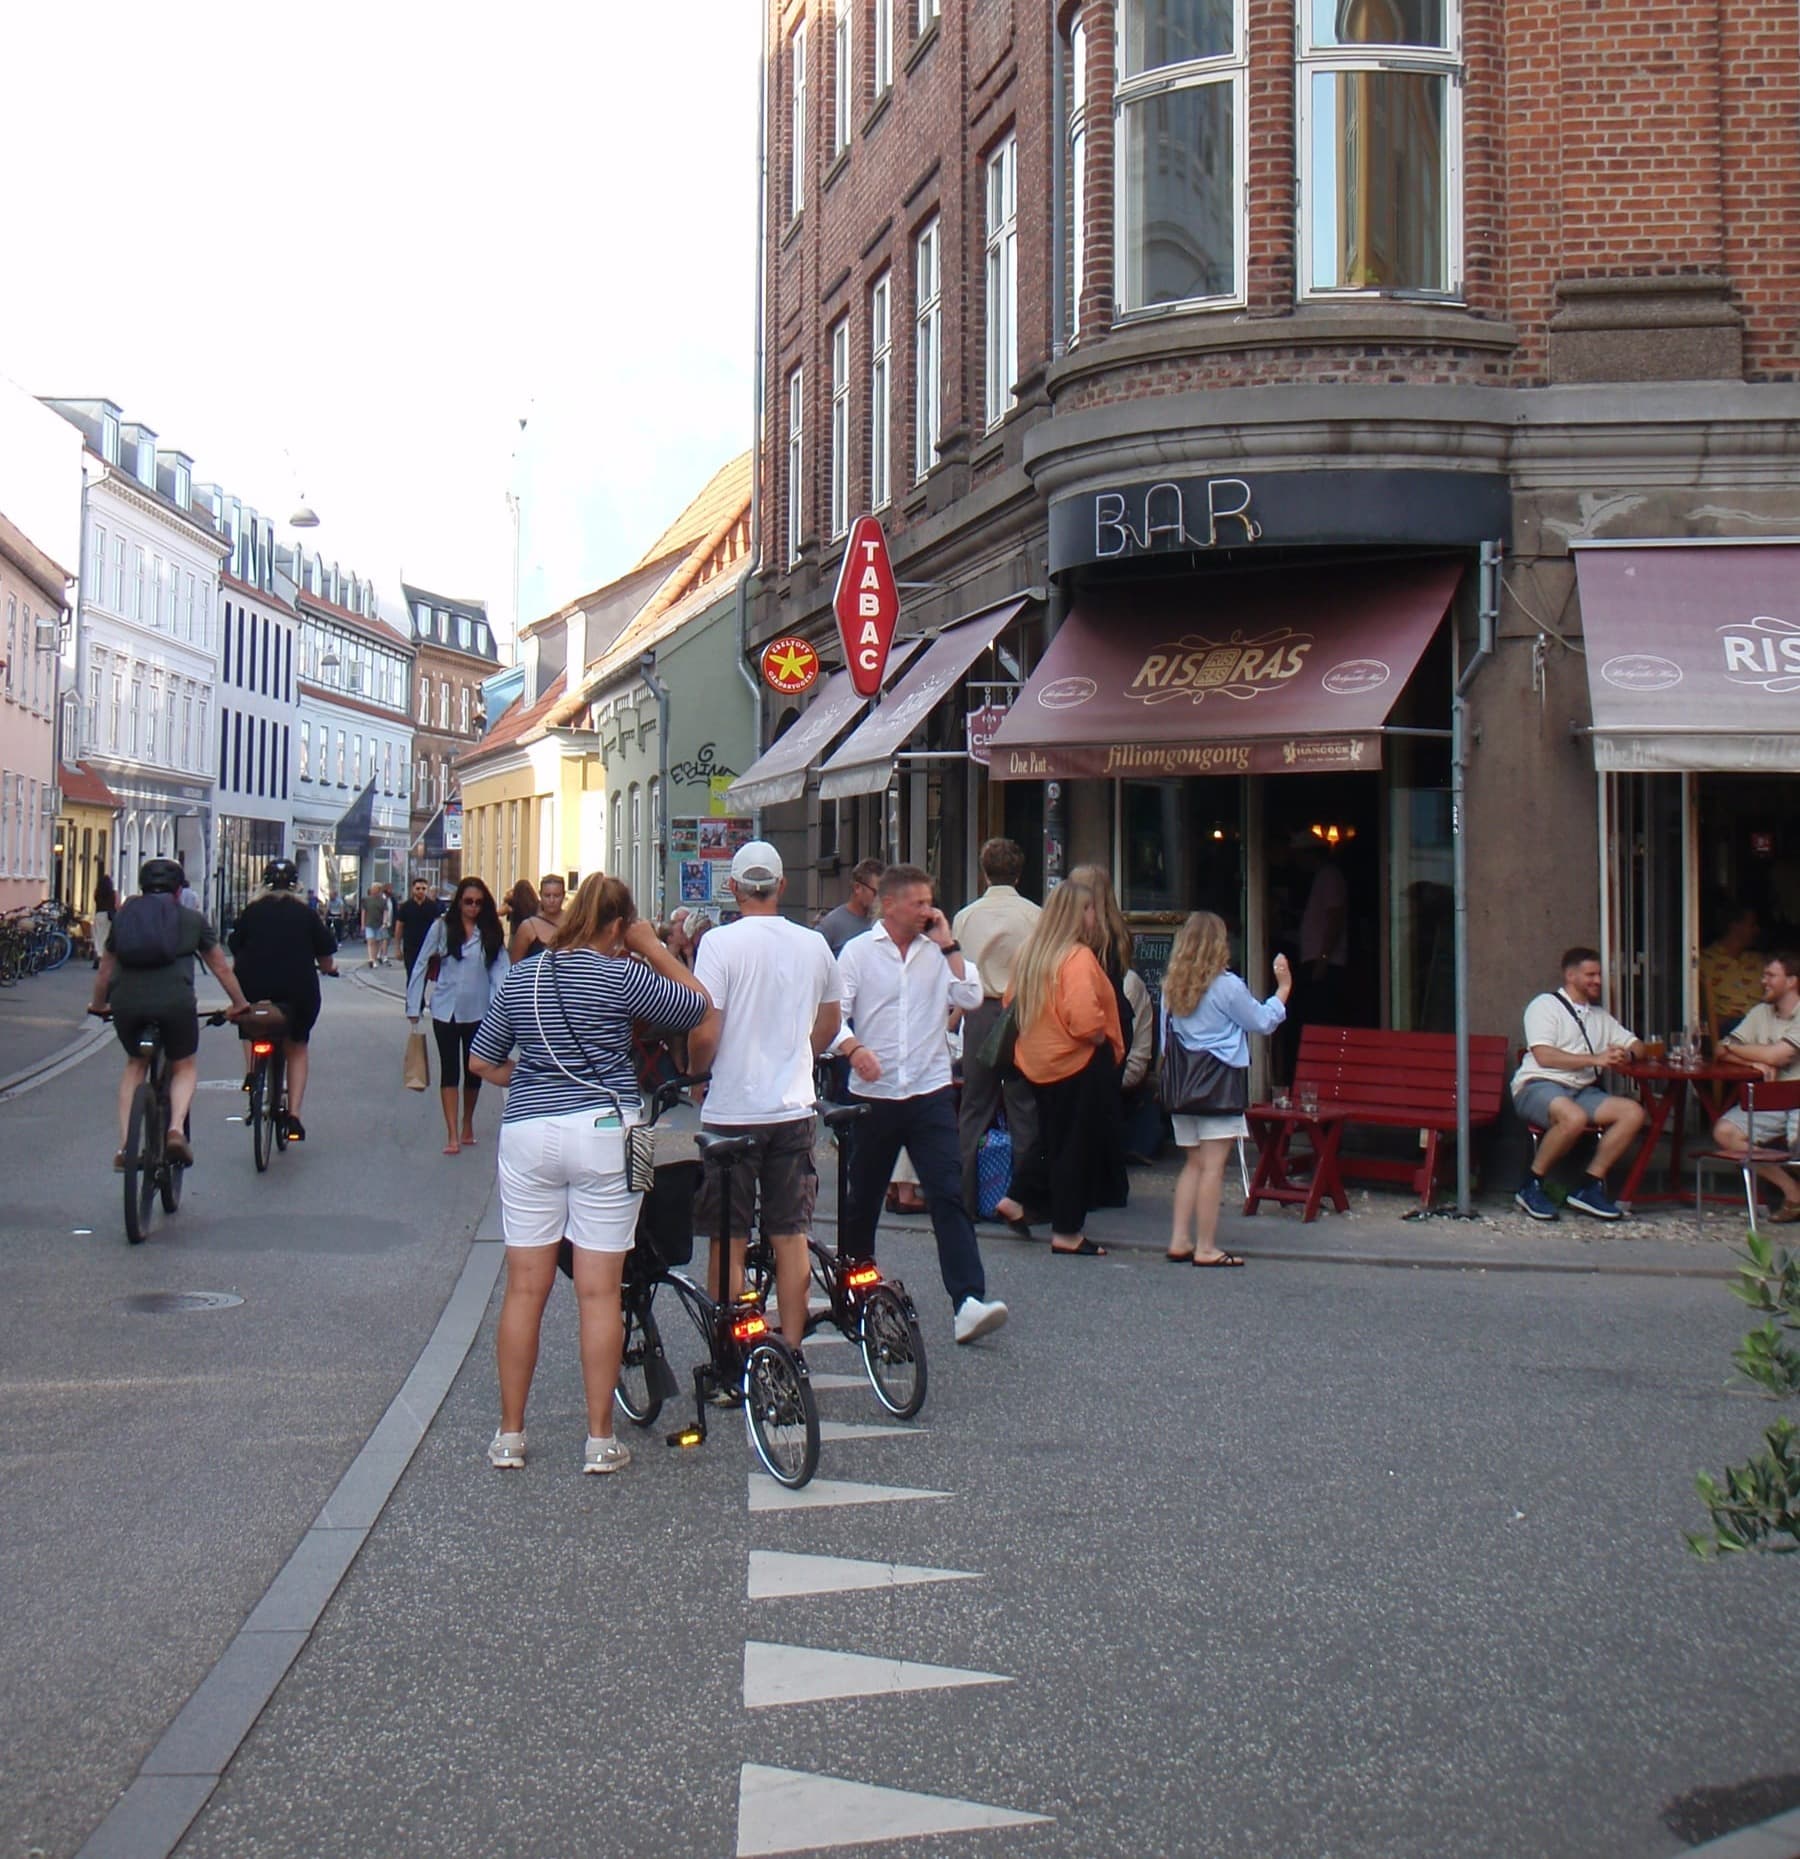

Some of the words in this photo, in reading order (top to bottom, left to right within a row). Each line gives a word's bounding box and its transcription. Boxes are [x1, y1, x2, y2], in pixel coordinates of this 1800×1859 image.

[1096, 478, 1260, 557] BAR
[859, 541, 880, 670] TABAC
[771, 640, 811, 653] EBELTOFT
[1131, 652, 1205, 688] RIS
[1228, 643, 1312, 682] RAS
[1723, 636, 1800, 673] RIS
[1010, 752, 1028, 774] One
[1030, 751, 1047, 774] Pint
